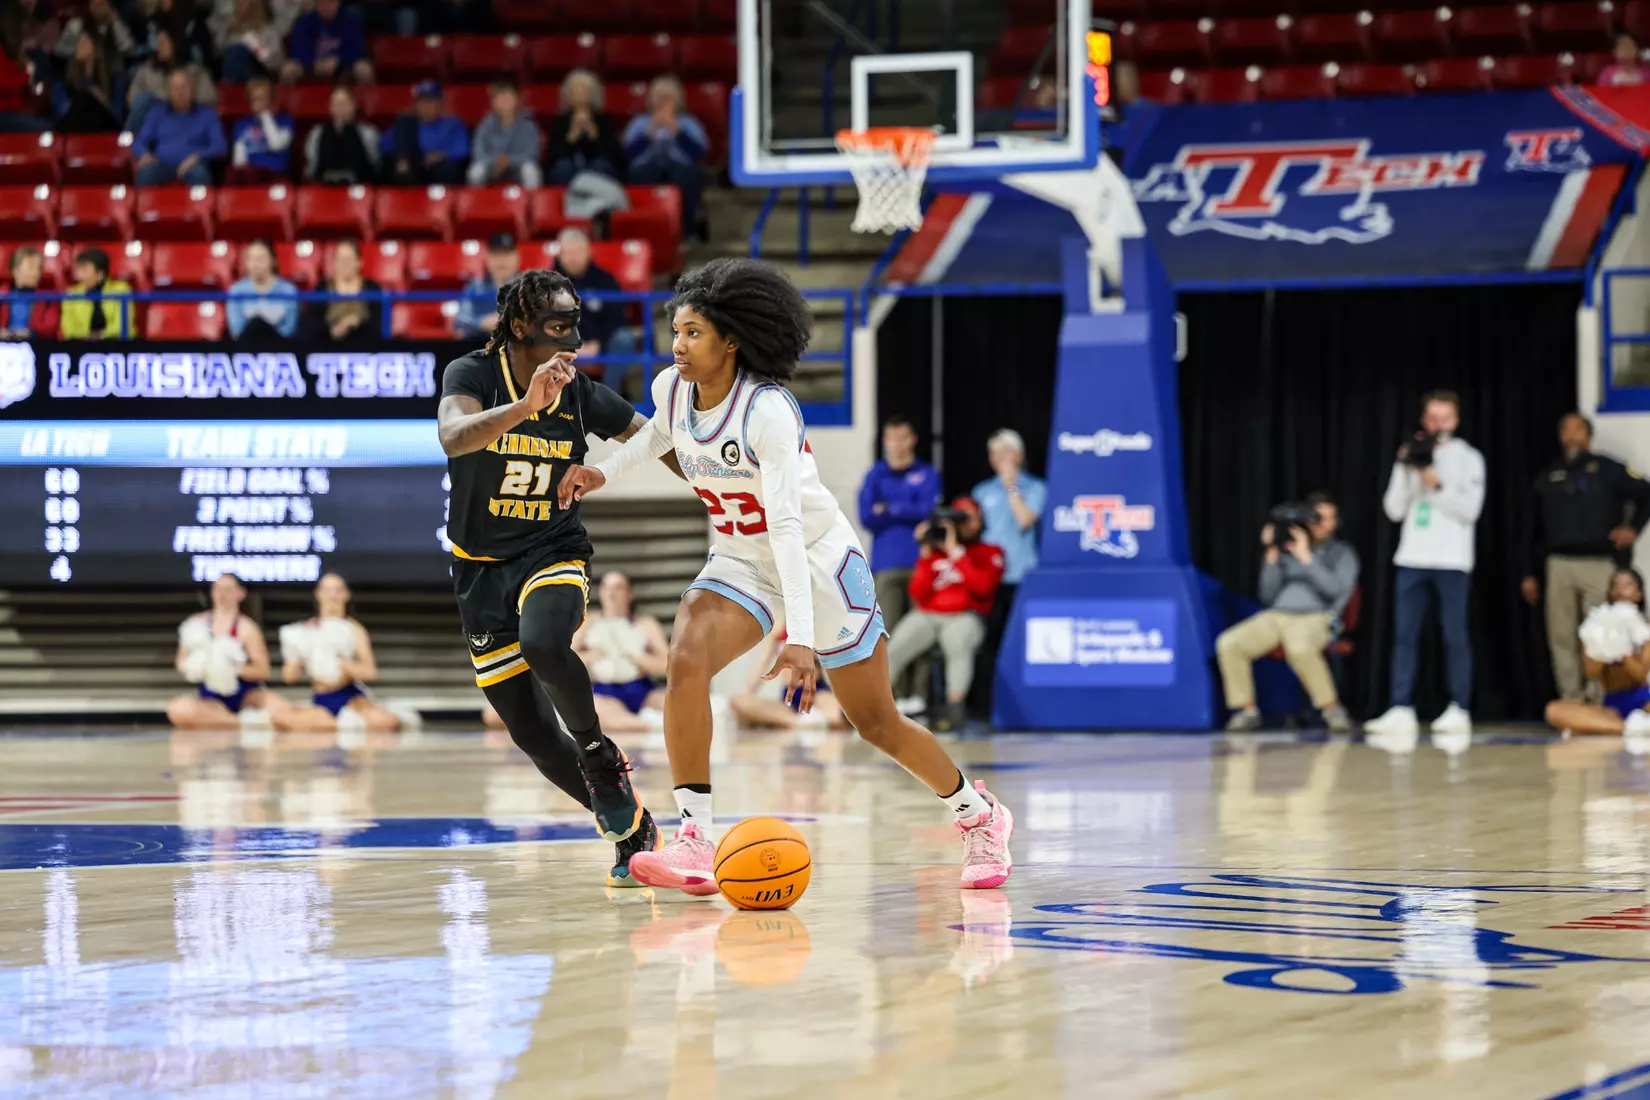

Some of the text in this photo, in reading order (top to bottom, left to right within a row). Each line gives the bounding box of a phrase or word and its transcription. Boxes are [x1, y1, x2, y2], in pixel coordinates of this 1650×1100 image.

[49, 353, 436, 398] LOUISIANA TECH
[499, 460, 552, 496] 21
[488, 497, 552, 521] STATE
[693, 486, 769, 536] 23
[755, 884, 794, 902] EVO
